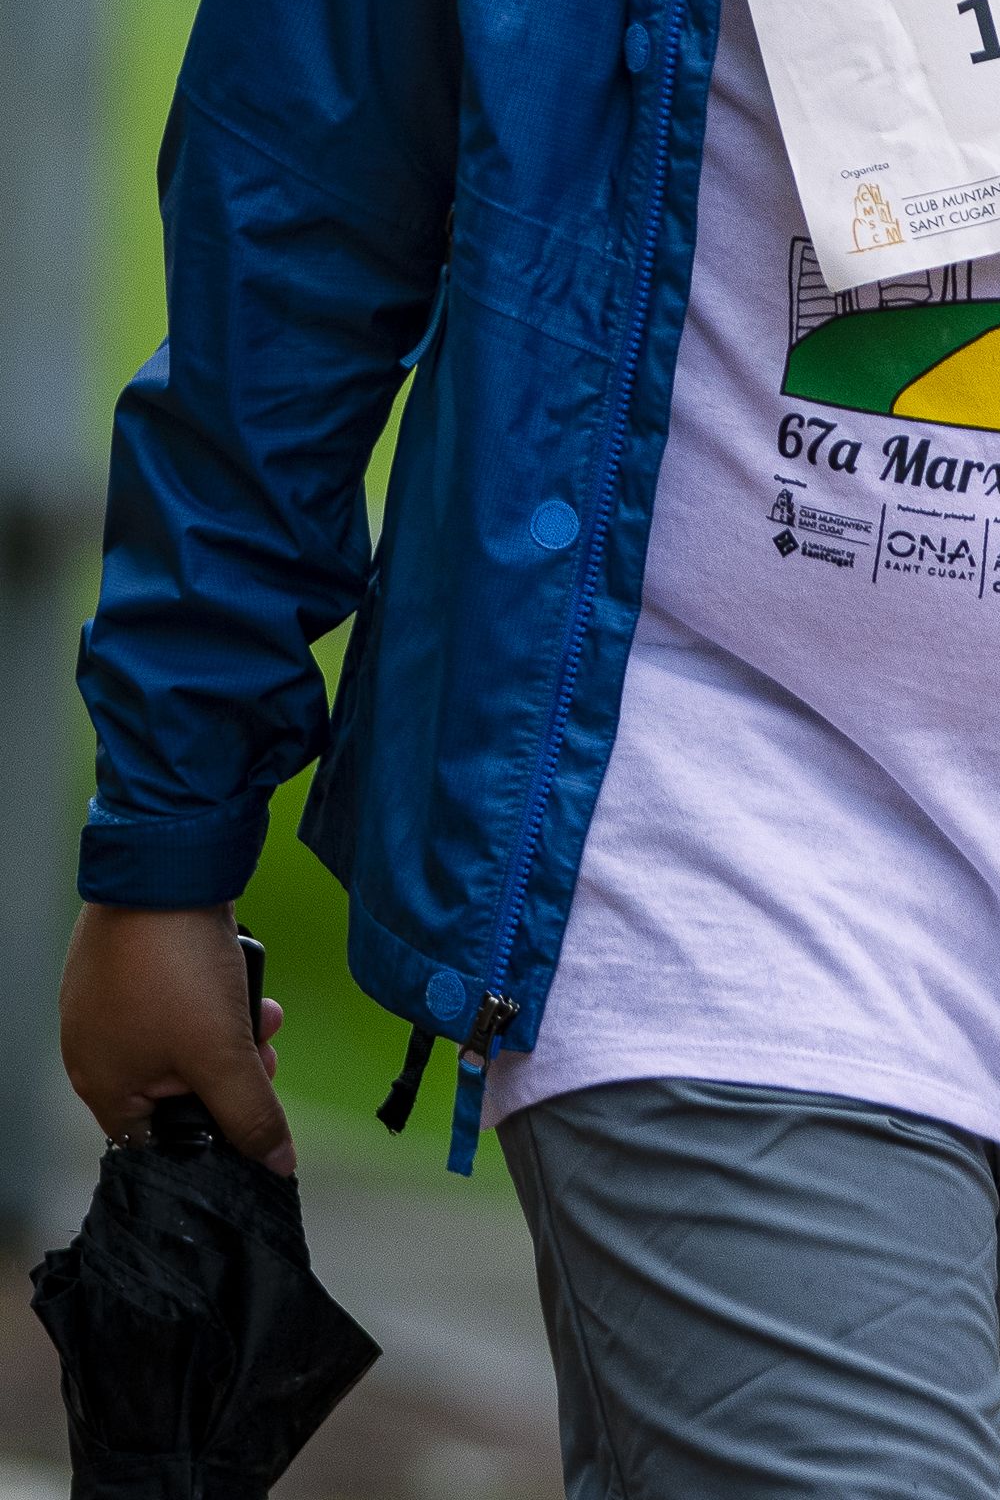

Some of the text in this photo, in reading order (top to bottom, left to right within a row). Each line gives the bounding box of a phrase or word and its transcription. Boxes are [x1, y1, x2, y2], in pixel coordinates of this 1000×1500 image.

[841, 162, 889, 179] Organitza
[904, 198, 938, 217] CLUB
[909, 203, 996, 233] SANT CUGAT
[777, 412, 862, 474] 67a
[887, 530, 976, 567] ONA
[884, 560, 974, 581] SANT CUGAT
